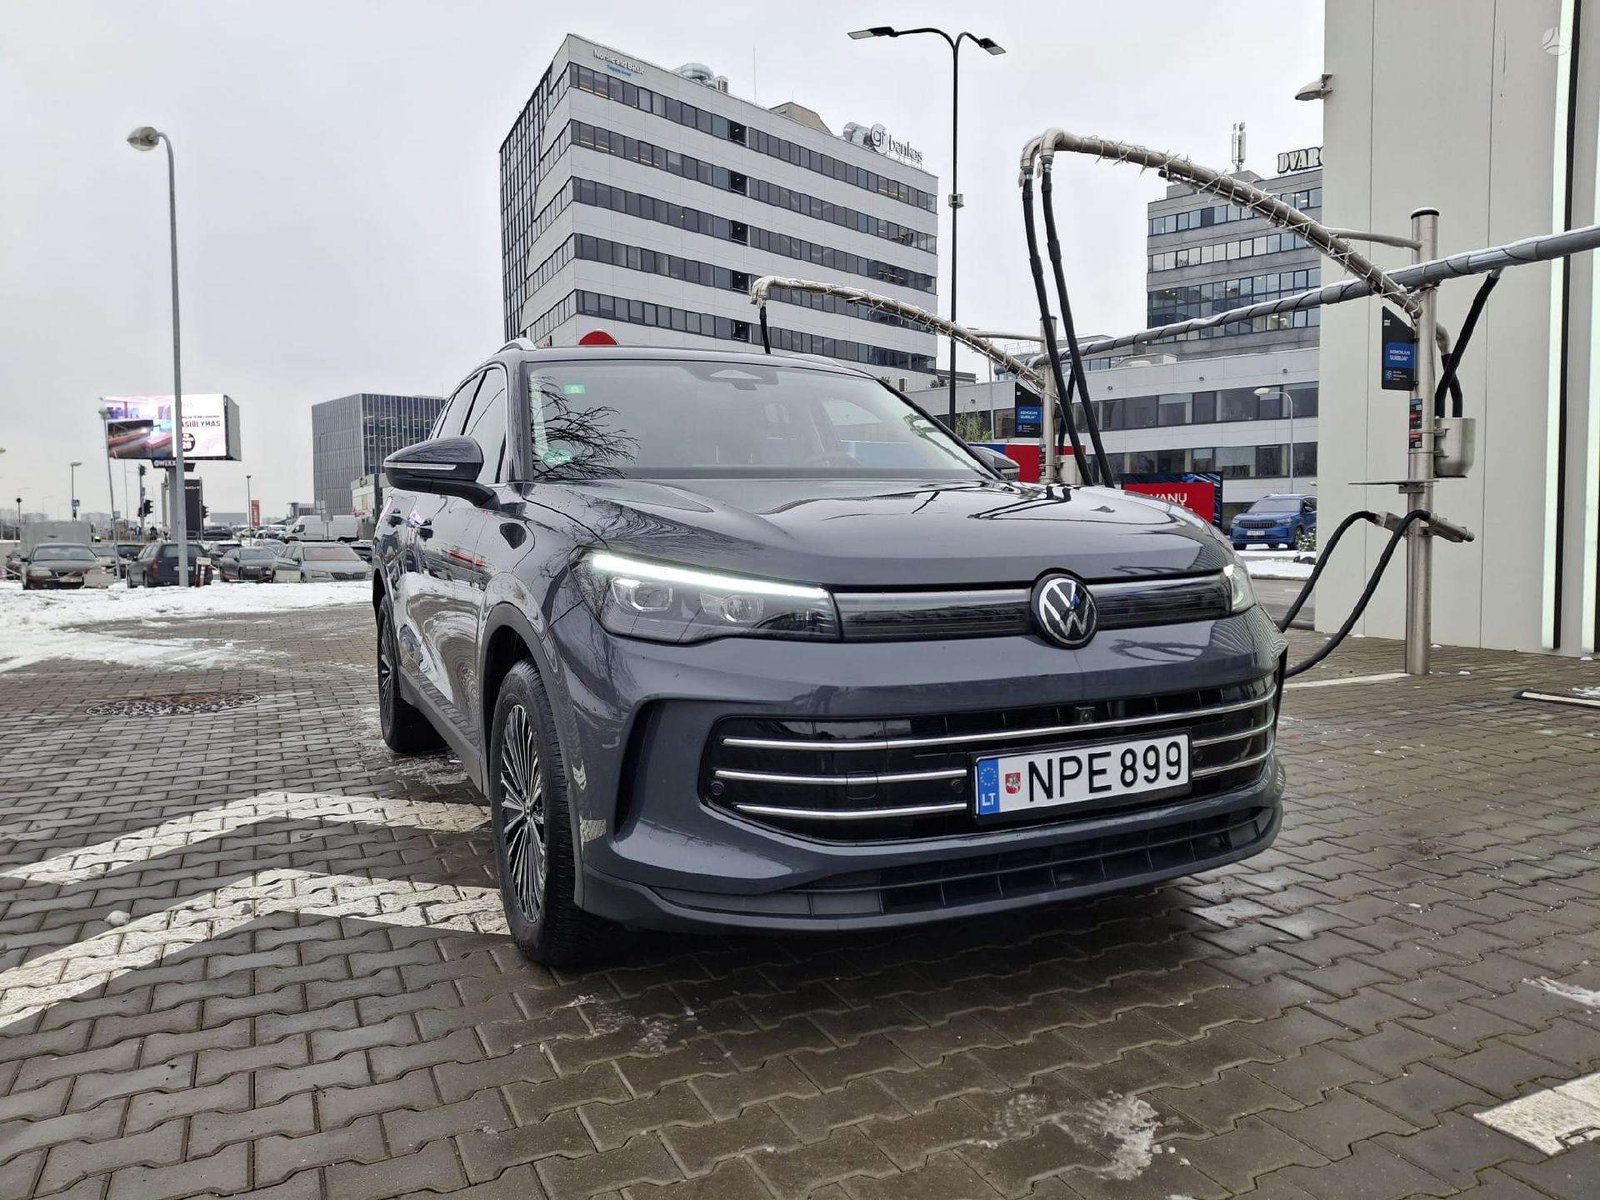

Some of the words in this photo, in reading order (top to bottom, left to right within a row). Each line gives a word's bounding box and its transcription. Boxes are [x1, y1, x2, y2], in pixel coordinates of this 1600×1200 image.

[888, 134, 923, 164] bankas
[1277, 146, 1324, 174] DVAR
[981, 793, 996, 807] LT
